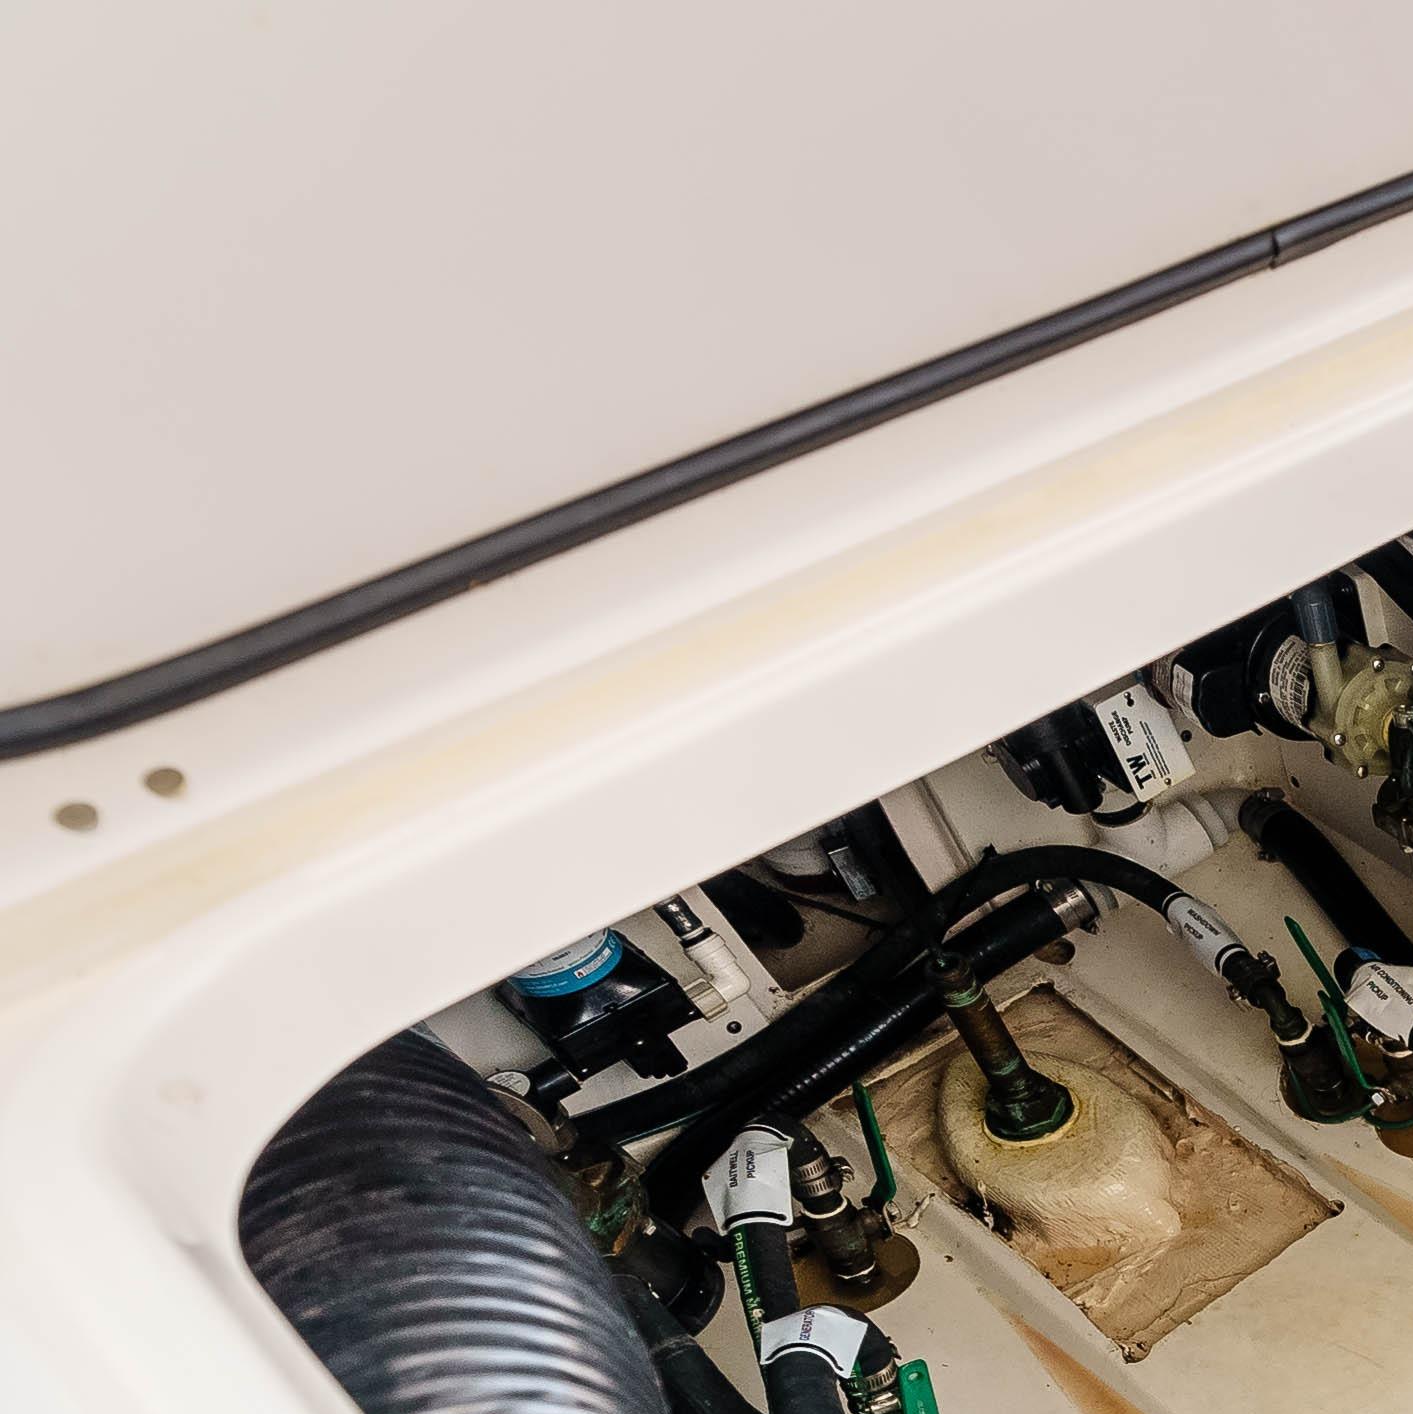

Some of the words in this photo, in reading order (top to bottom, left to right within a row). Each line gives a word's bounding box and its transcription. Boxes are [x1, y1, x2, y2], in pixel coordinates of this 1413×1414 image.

[1184, 922, 1204, 941] PICKUP
[1187, 908, 1222, 937] WASHDOWN
[1368, 963, 1380, 977] AIR
[1366, 980, 1389, 1002] PICKUP
[729, 1150, 738, 1188] BAITWELL
[746, 1150, 756, 1180] PICKUP
[733, 1232, 752, 1296] PREMIUM
